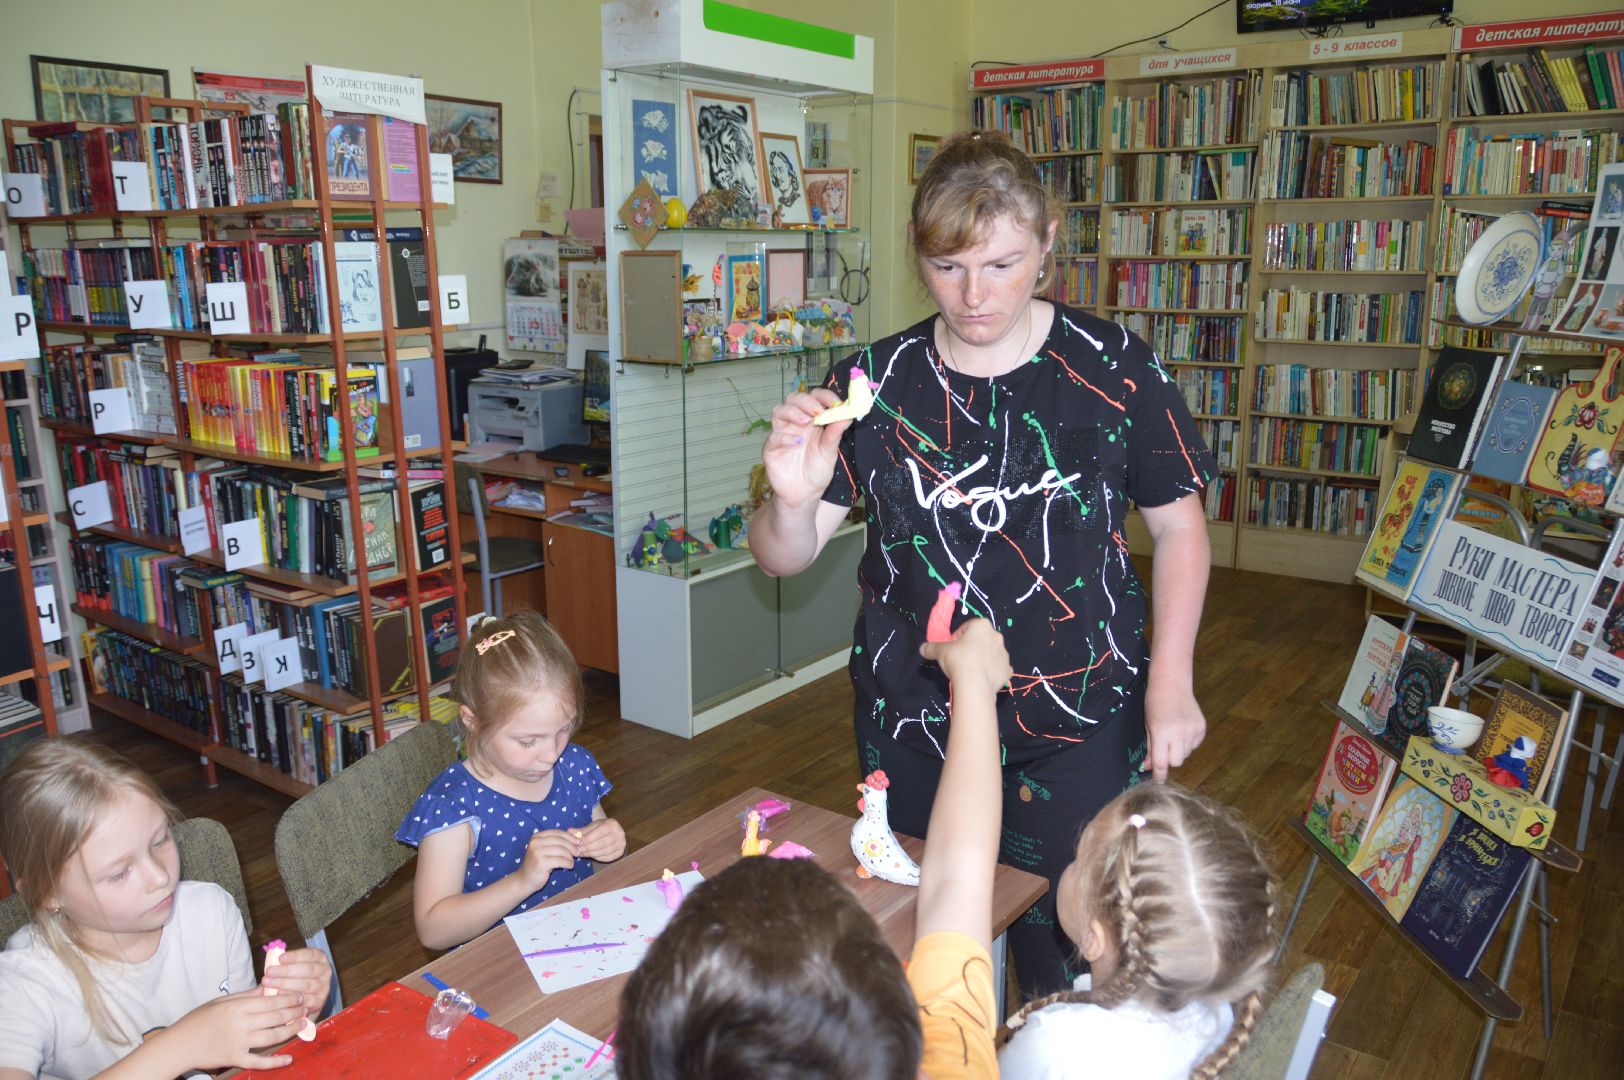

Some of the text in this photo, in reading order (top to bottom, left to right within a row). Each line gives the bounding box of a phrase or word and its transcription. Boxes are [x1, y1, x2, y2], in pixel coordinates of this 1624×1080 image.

[1476, 28, 1540, 42] детская
[1313, 44, 1321, 55] 5
[1332, 42, 1339, 53] 9
[1344, 38, 1398, 52] классов
[1148, 54, 1232, 70] для учащихся
[984, 65, 1094, 82] детская литература
[322, 76, 415, 96] ХУДОЖЕСТВЕННАЯ
[115, 176, 128, 194] Т
[329, 180, 368, 192] ПРЕЗИДЕНТА
[7, 187, 22, 204] О
[129, 294, 144, 313] У
[447, 292, 460, 310] Б
[211, 302, 236, 322] Ш
[14, 312, 32, 336] Р
[93, 402, 106, 420] Р
[905, 454, 1081, 532] Vogue
[72, 500, 86, 516] С
[226, 538, 240, 556] В
[1449, 536, 1496, 582] РУКИ
[1493, 556, 1580, 616] МАСТЕРА
[1433, 568, 1478, 612] ДИВНОЕ
[1481, 588, 1516, 627] ДИВО
[36, 603, 56, 624] Ч
[220, 638, 236, 662] Д
[242, 652, 256, 670] З
